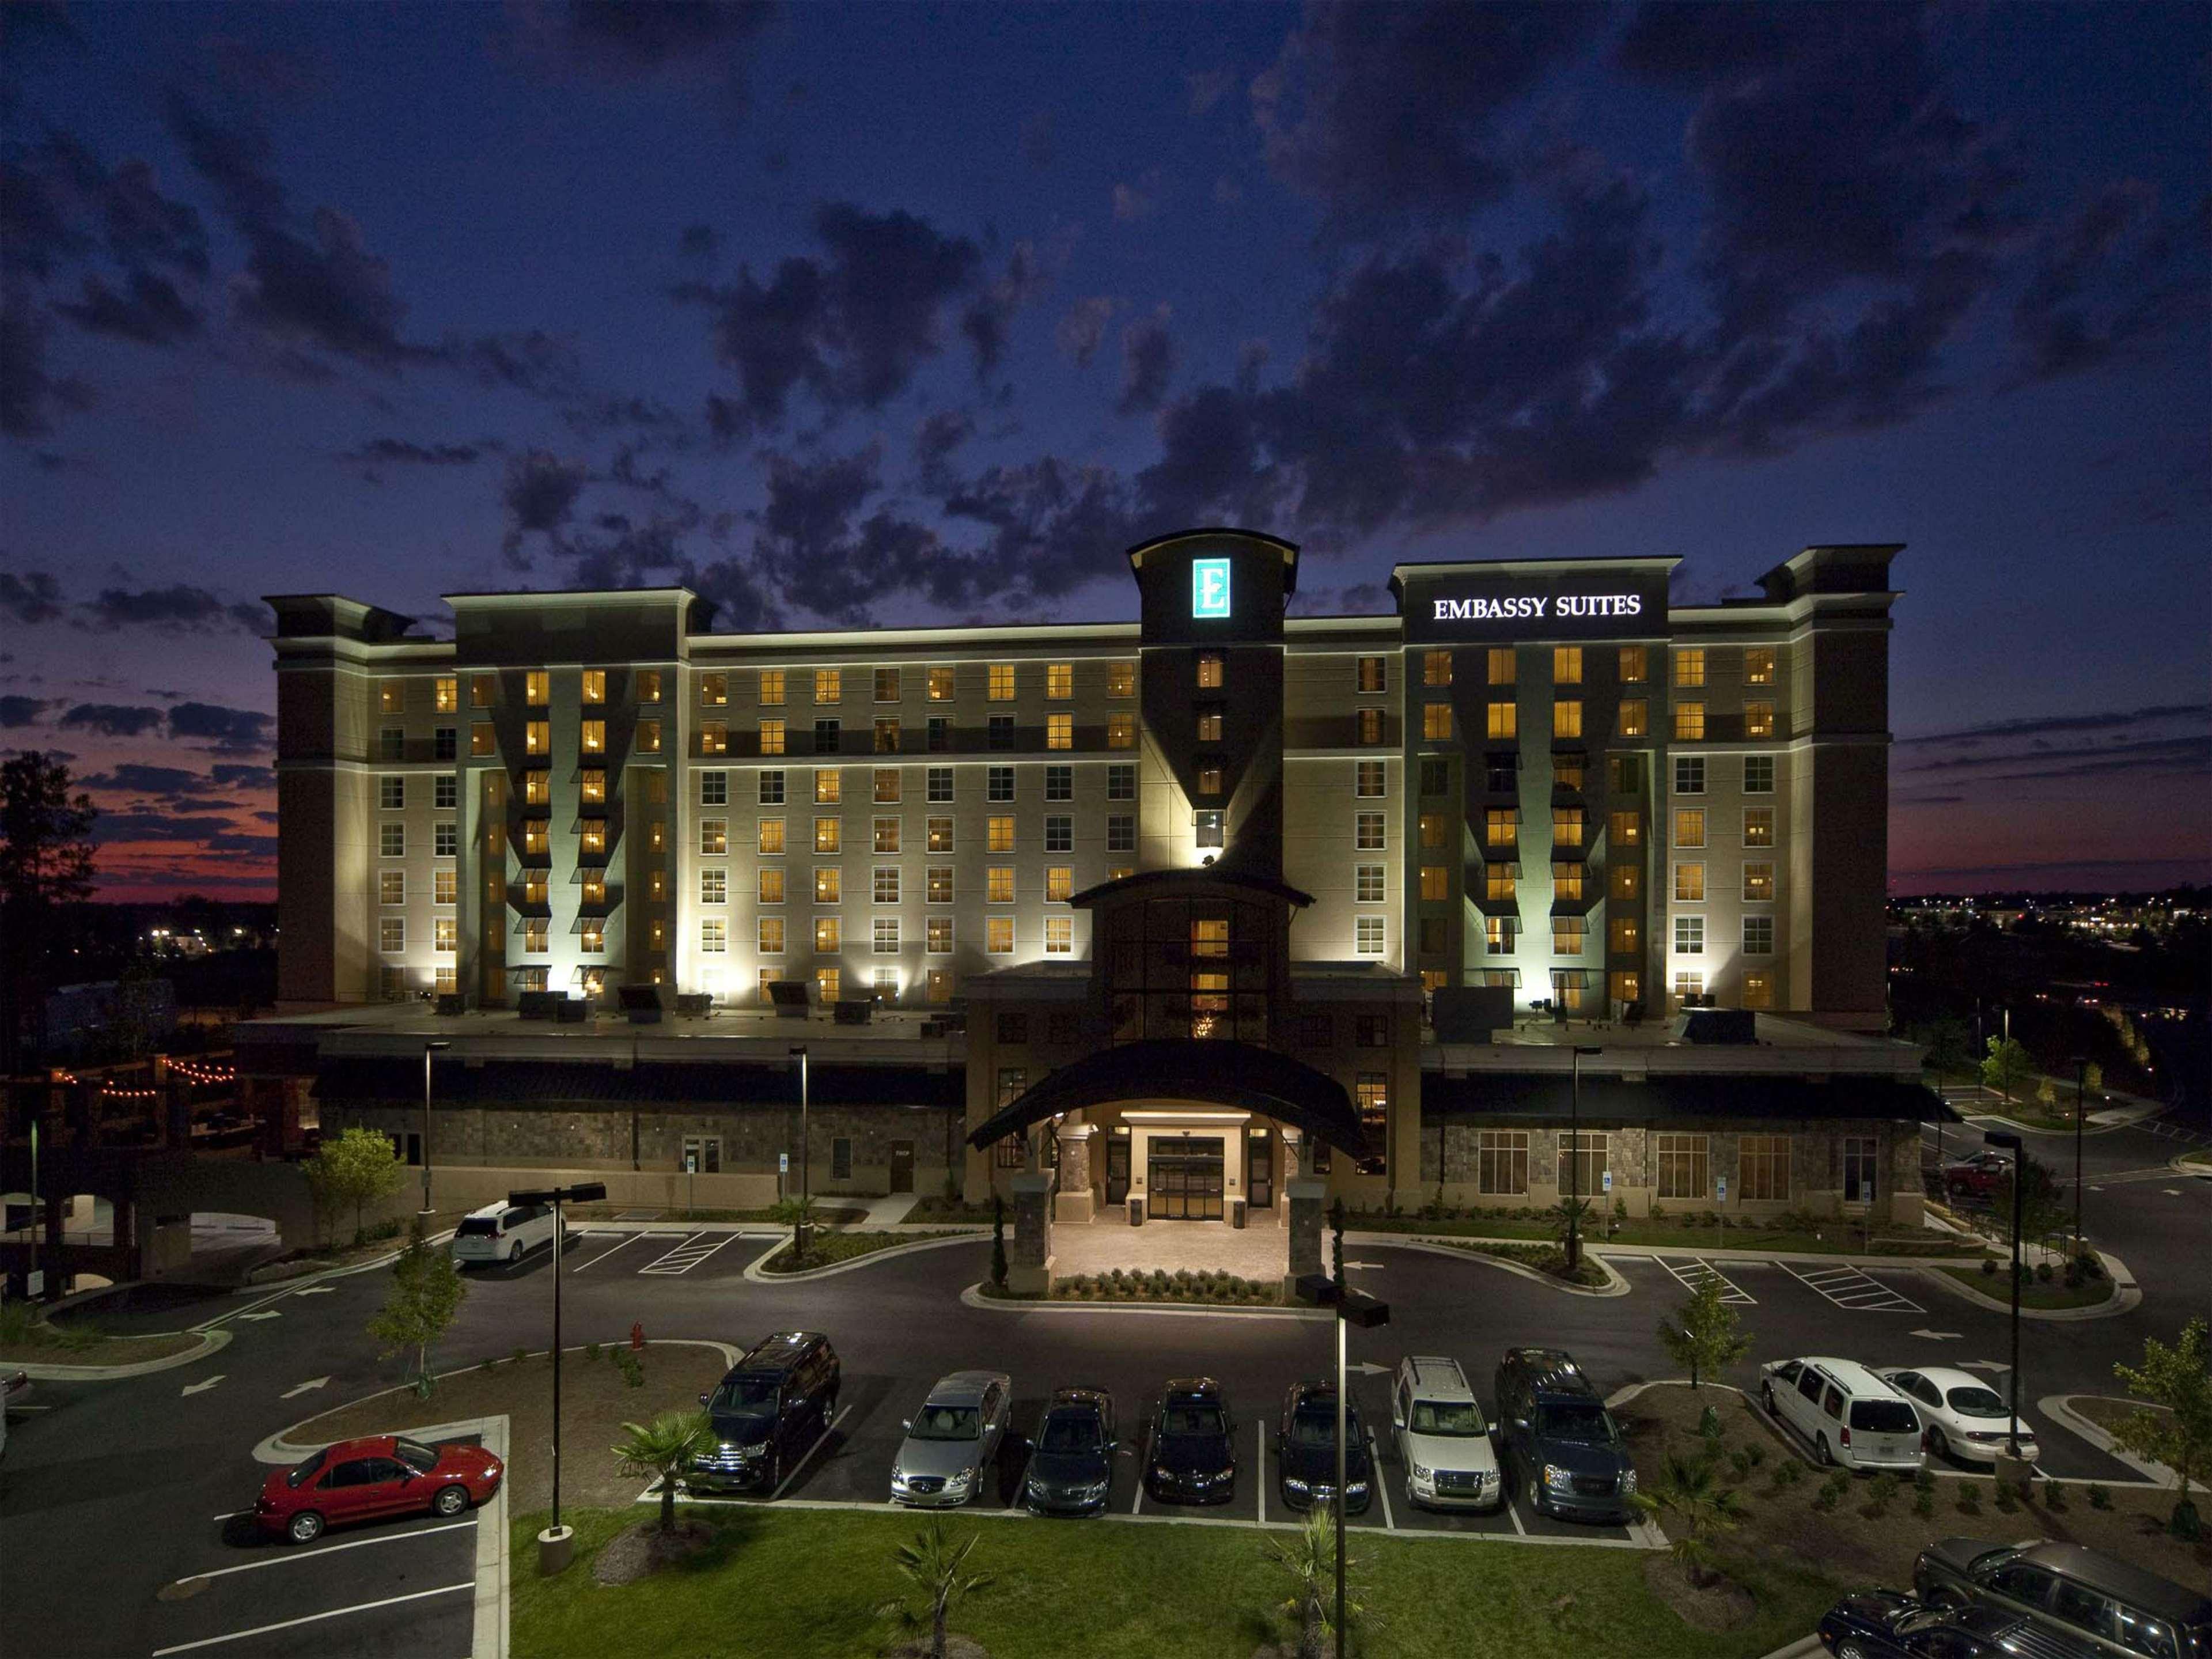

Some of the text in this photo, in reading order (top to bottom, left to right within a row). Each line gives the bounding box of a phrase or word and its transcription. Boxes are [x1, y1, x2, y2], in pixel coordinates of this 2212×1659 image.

[1200, 568, 1225, 609] E
[1434, 594, 1641, 619] EMBASSY SUITES
